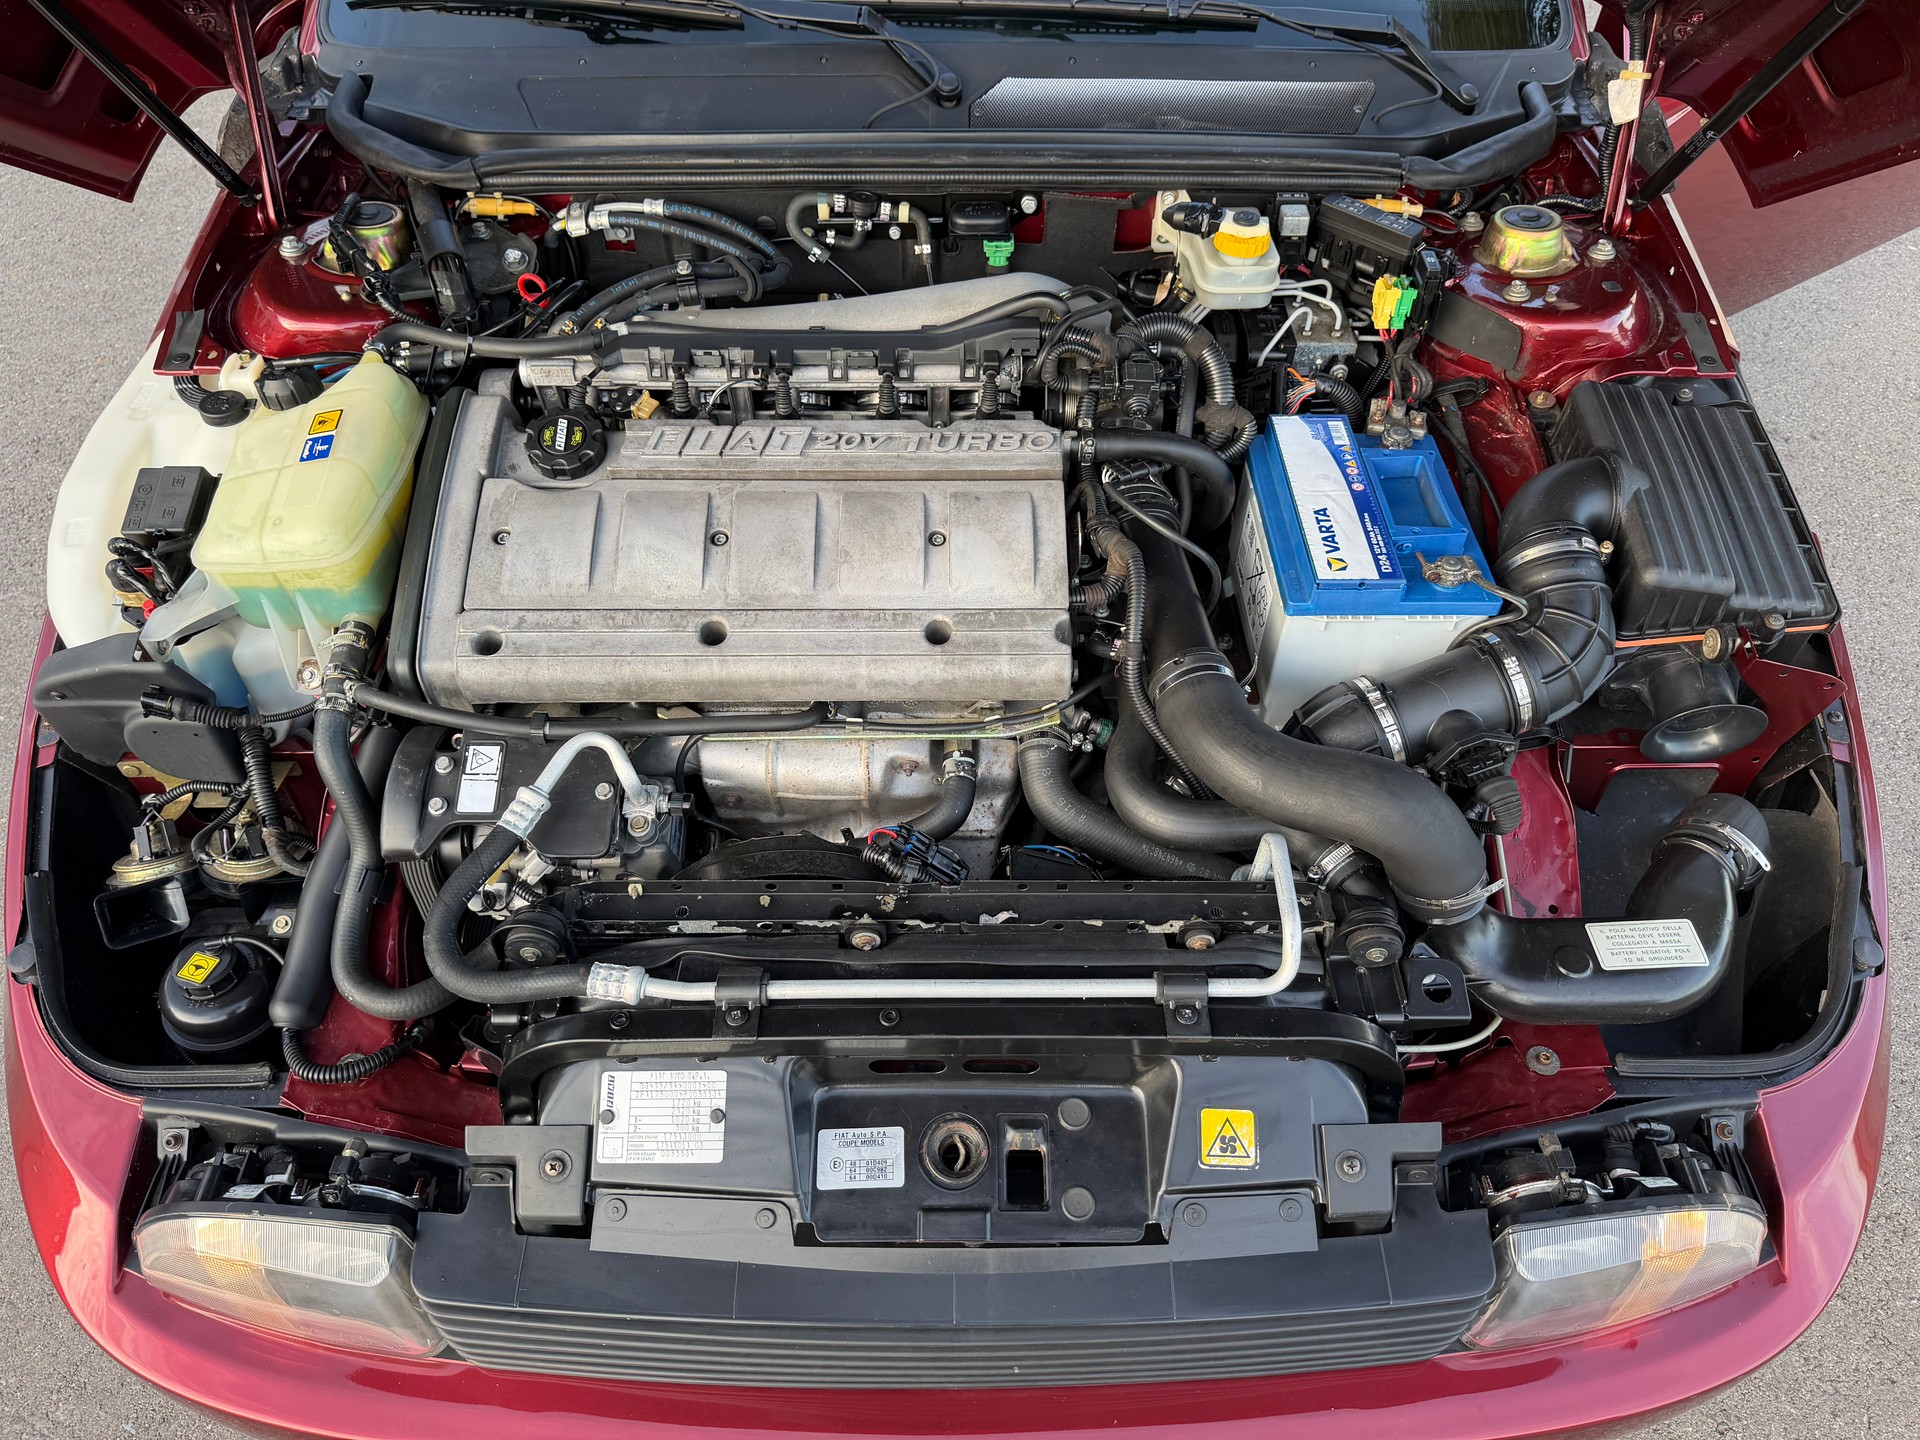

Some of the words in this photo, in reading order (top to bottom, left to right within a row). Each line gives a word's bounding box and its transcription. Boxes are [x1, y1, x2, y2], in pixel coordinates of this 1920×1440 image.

[555, 418, 567, 451] FIAT
[650, 427, 812, 456] FIAT
[898, 432, 1054, 452] TURBO
[1313, 508, 1340, 553] VARTA
[1380, 555, 1392, 573] D24
[607, 1075, 615, 1108] FIAT
[693, 1099, 701, 1107] kg
